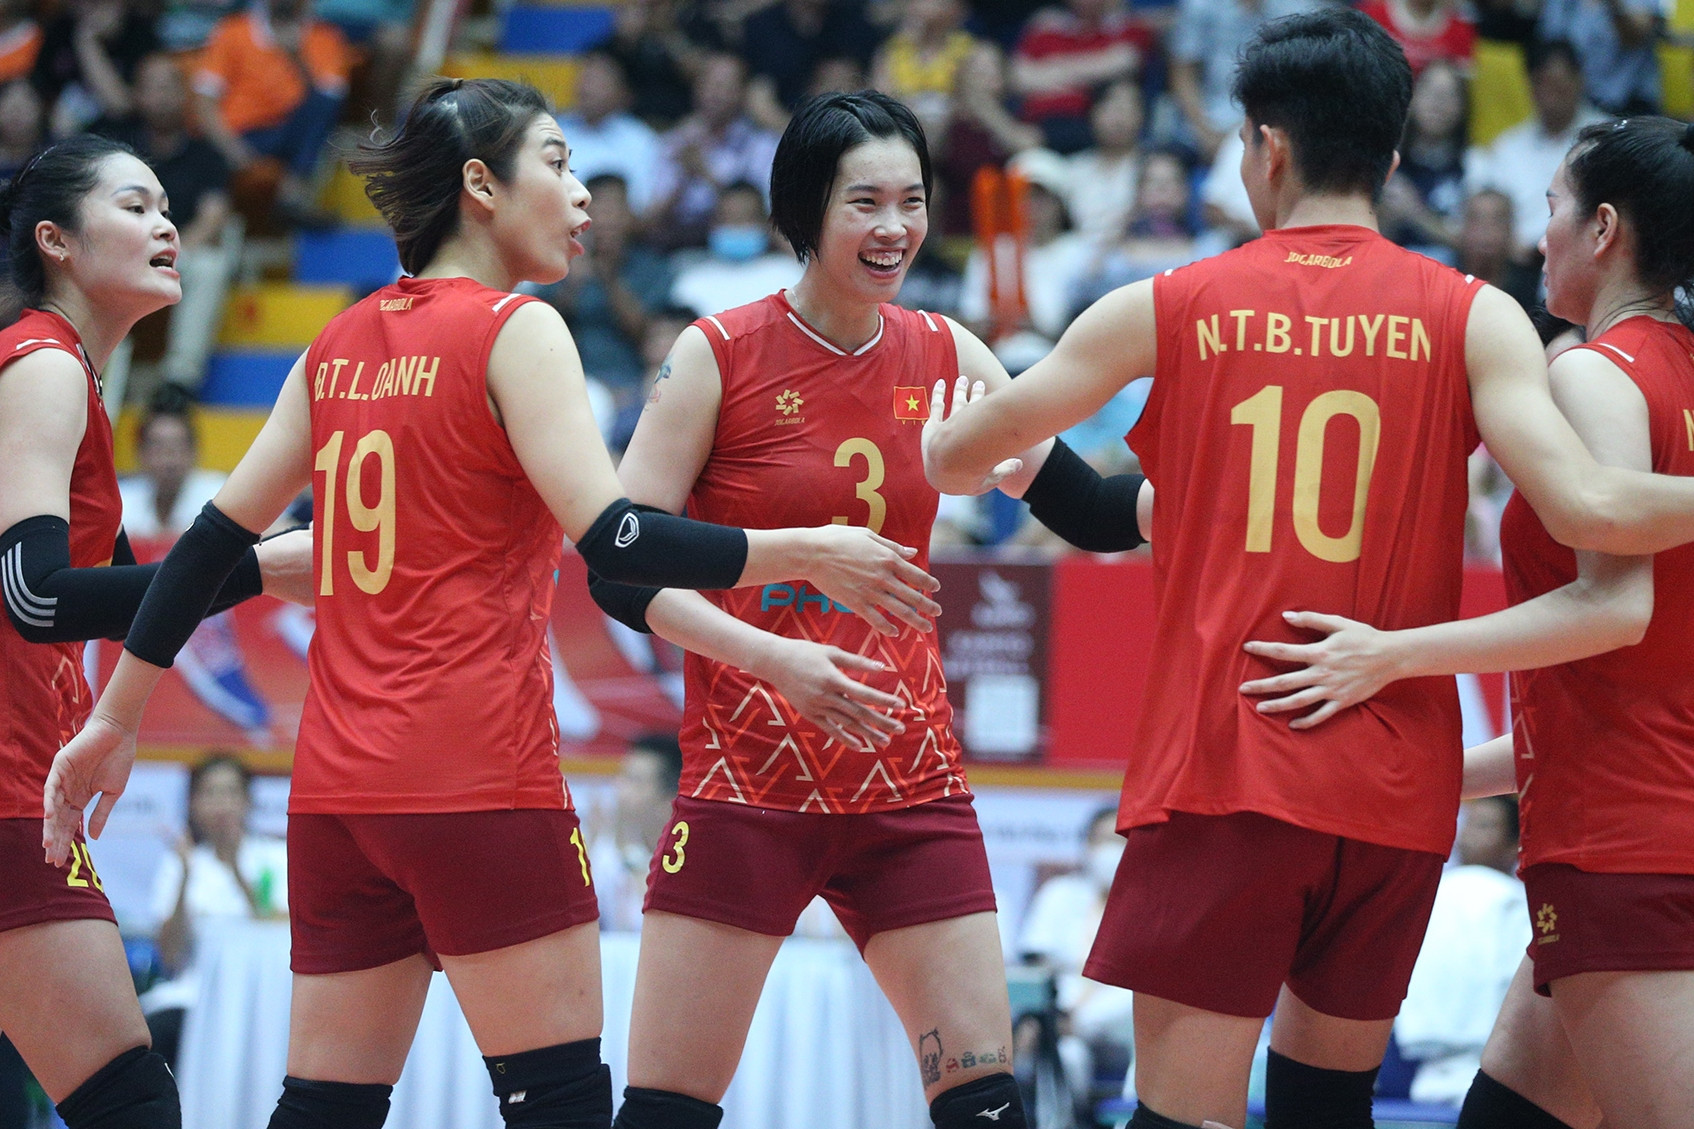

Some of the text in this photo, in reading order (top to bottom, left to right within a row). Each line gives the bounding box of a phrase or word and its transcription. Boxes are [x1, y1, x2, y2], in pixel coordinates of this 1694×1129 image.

[1283, 251, 1353, 269] JOGARBOLA
[1196, 309, 1431, 363] N.T.B.TUYEN
[831, 437, 887, 535] 3
[1230, 384, 1382, 563] 10
[314, 429, 396, 596] 19
[662, 820, 690, 874] 3
